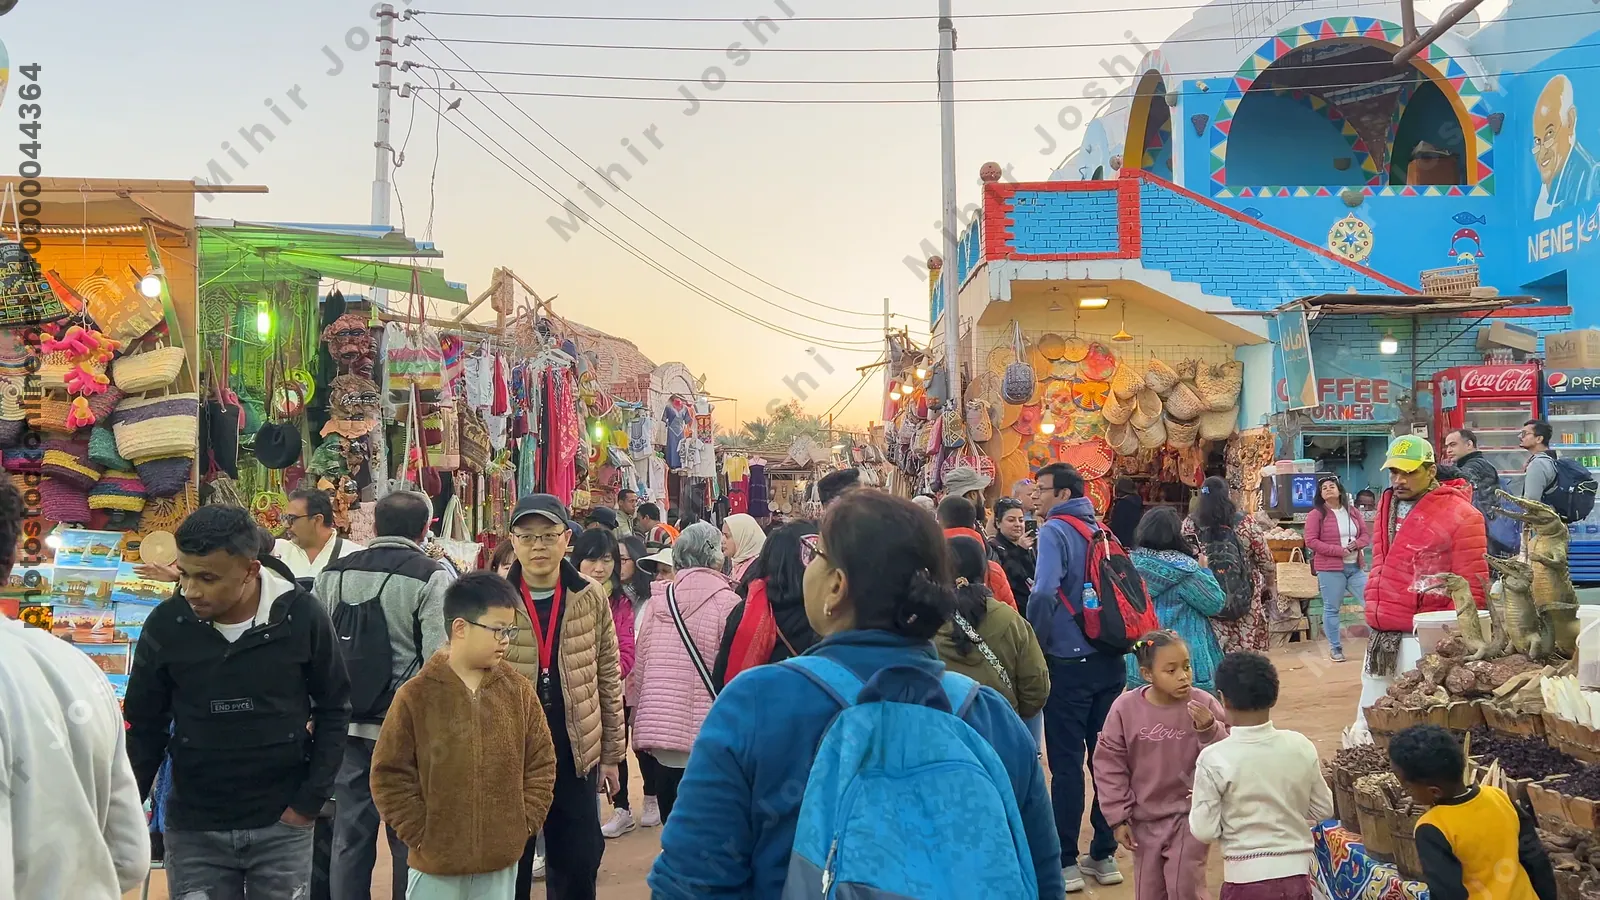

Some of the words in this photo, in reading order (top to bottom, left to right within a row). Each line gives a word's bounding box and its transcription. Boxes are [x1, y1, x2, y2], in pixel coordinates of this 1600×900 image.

[1527, 220, 1574, 264] NENE
[1276, 378, 1390, 404] CFFEE
[1460, 368, 1536, 392] Coca-Cola
[1310, 403, 1375, 421] ORNER
